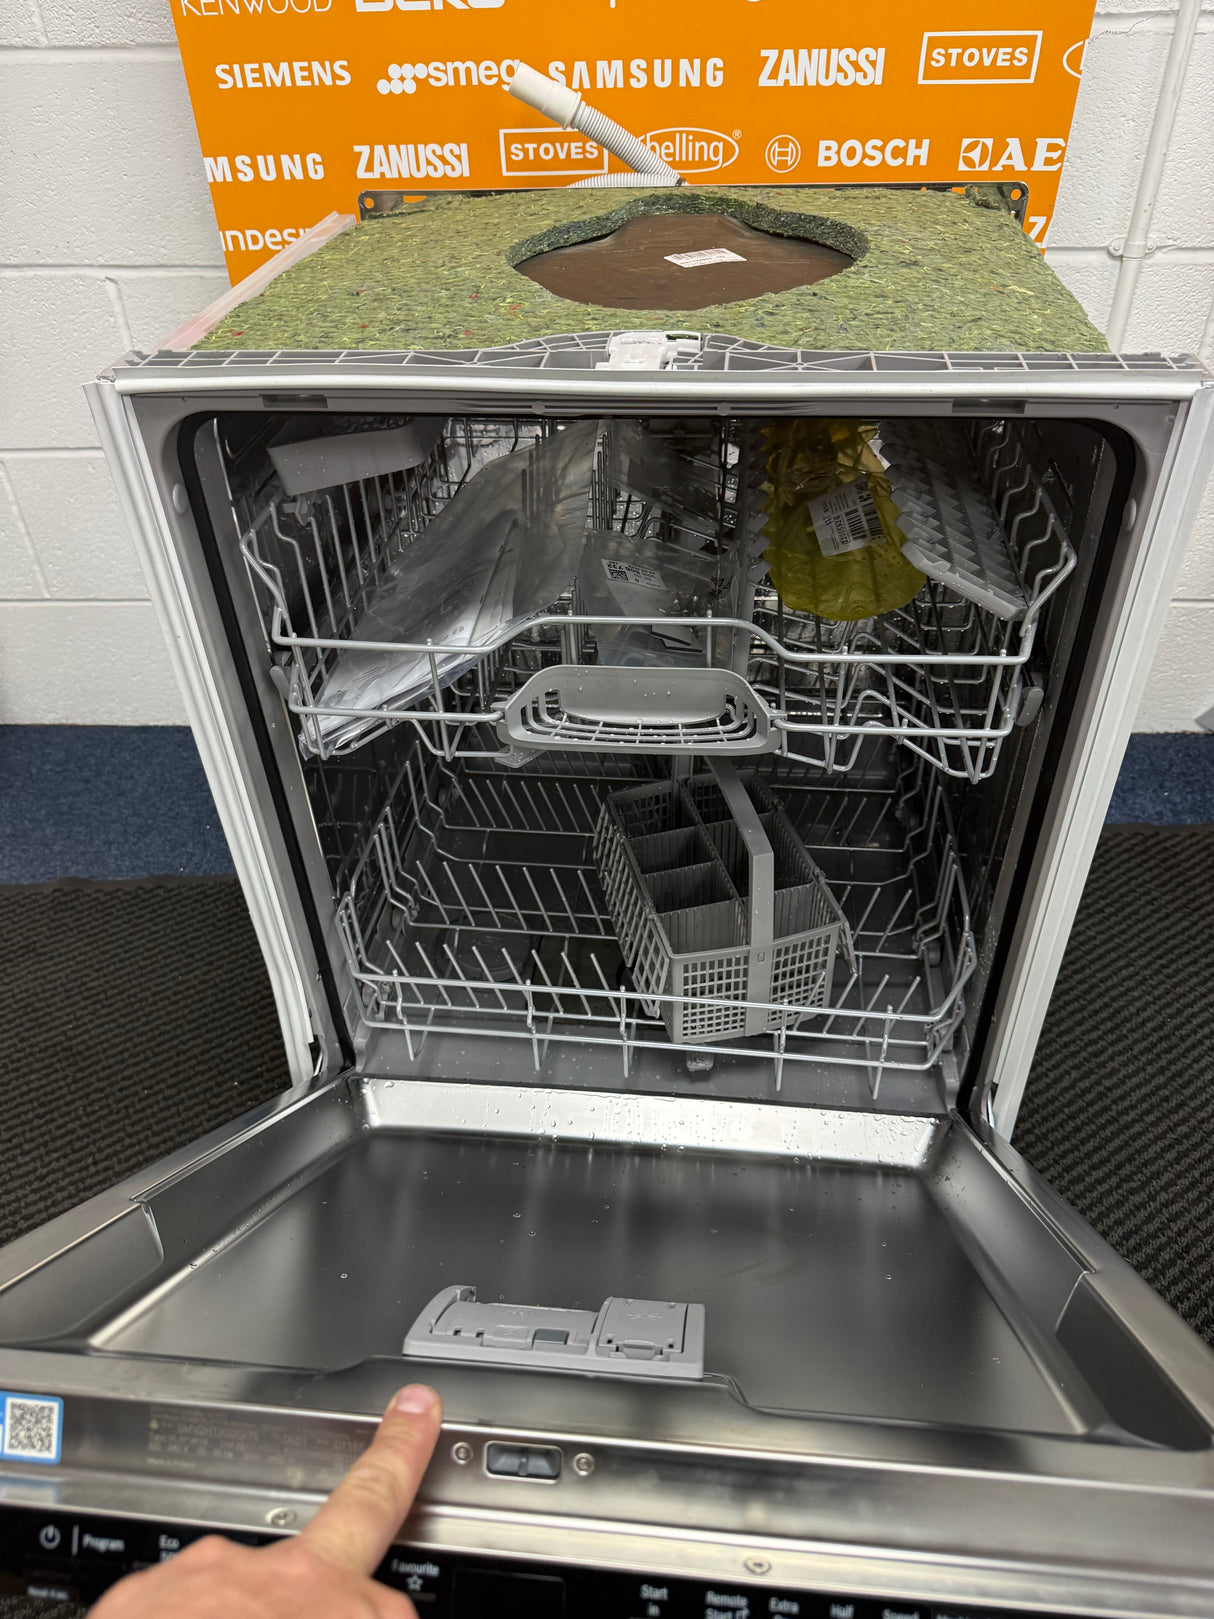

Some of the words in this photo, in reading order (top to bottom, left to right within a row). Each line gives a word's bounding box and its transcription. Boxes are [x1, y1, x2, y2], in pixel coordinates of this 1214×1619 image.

[758, 47, 886, 87] ZANUSSI
[930, 47, 1029, 68] STOVES
[215, 60, 352, 90] SIEMENS
[428, 59, 520, 92] smeg
[549, 57, 724, 90] SAMSUNG
[353, 143, 470, 179] ZANUSSI
[510, 141, 599, 161] STOVES
[817, 138, 930, 167] BOSCH
[83, 1533, 125, 1552] Program
[159, 1534, 180, 1549] Eco
[392, 1559, 440, 1577] Favourite
[640, 1584, 668, 1600] Start
[706, 1591, 748, 1607] Remote
[647, 1602, 660, 1616] in
[769, 1597, 799, 1615] Extra
